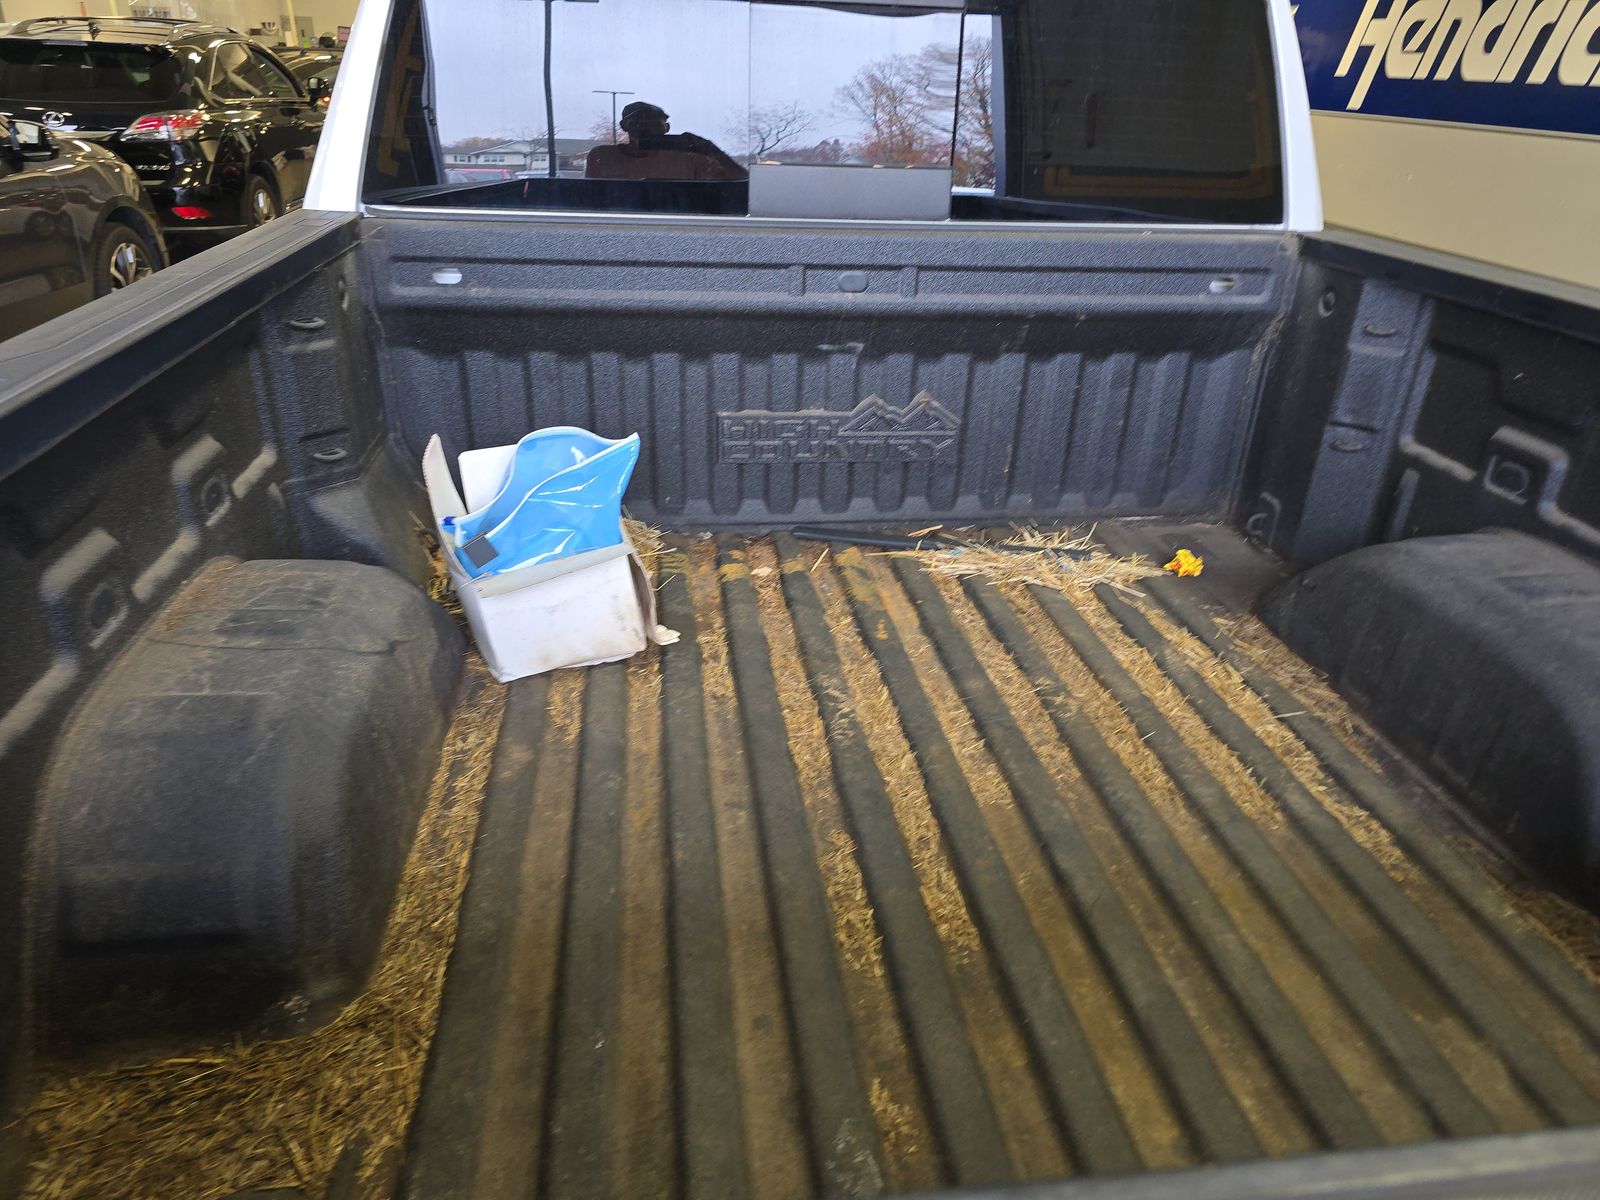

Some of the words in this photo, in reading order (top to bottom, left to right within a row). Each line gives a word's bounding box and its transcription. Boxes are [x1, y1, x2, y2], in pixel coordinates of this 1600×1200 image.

[1333, 0, 1600, 111] Hendric
[722, 418, 841, 438] HIGH
[722, 439, 954, 462] COUNTRY
